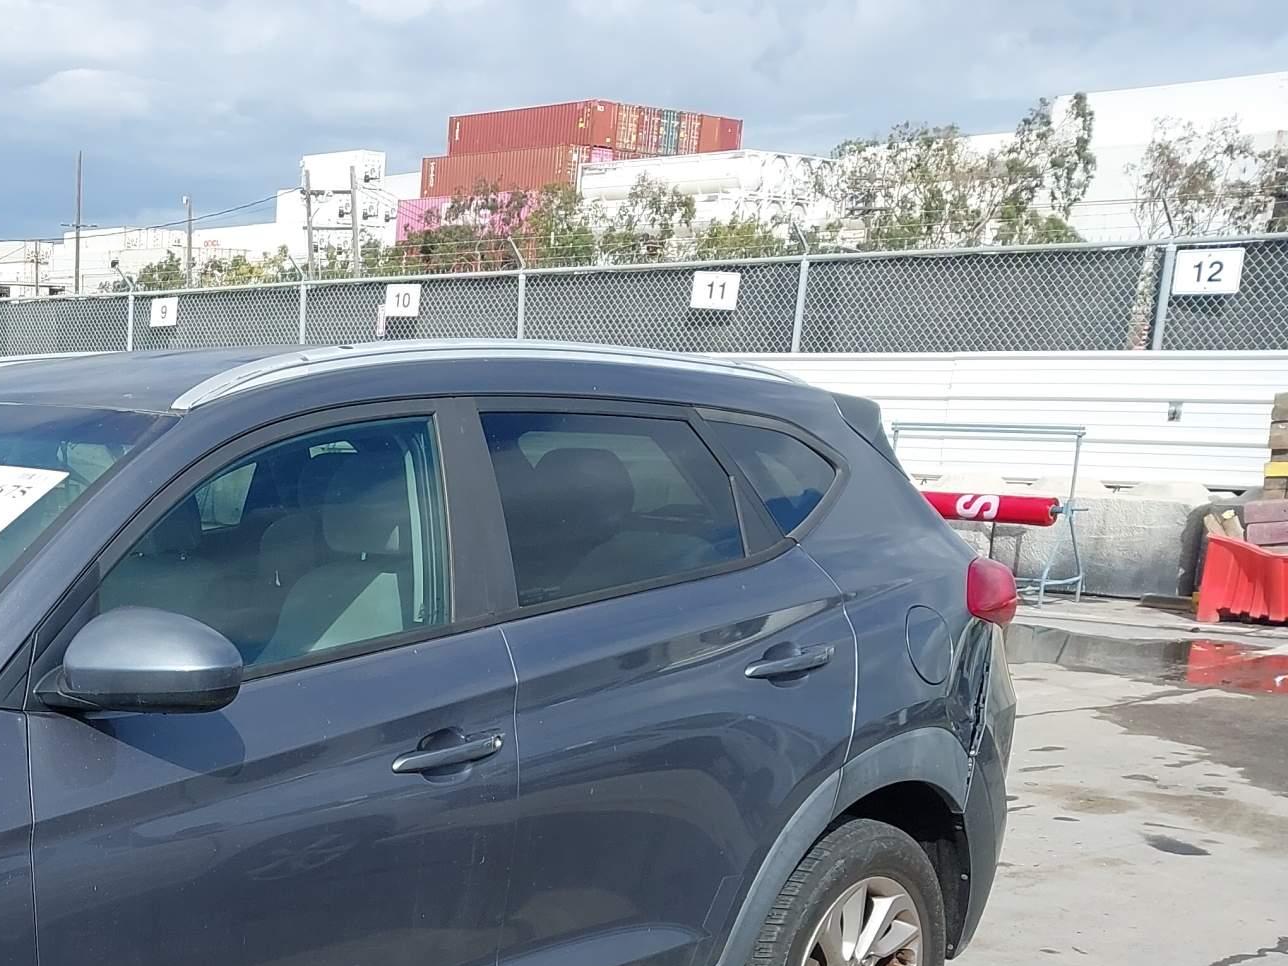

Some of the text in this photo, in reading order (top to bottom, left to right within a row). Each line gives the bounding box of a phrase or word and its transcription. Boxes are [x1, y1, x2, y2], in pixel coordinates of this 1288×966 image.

[1193, 260, 1224, 282] 12
[706, 281, 726, 299] 11
[395, 292, 411, 308] 10
[160, 305, 168, 320] 9
[955, 494, 1000, 520] S
